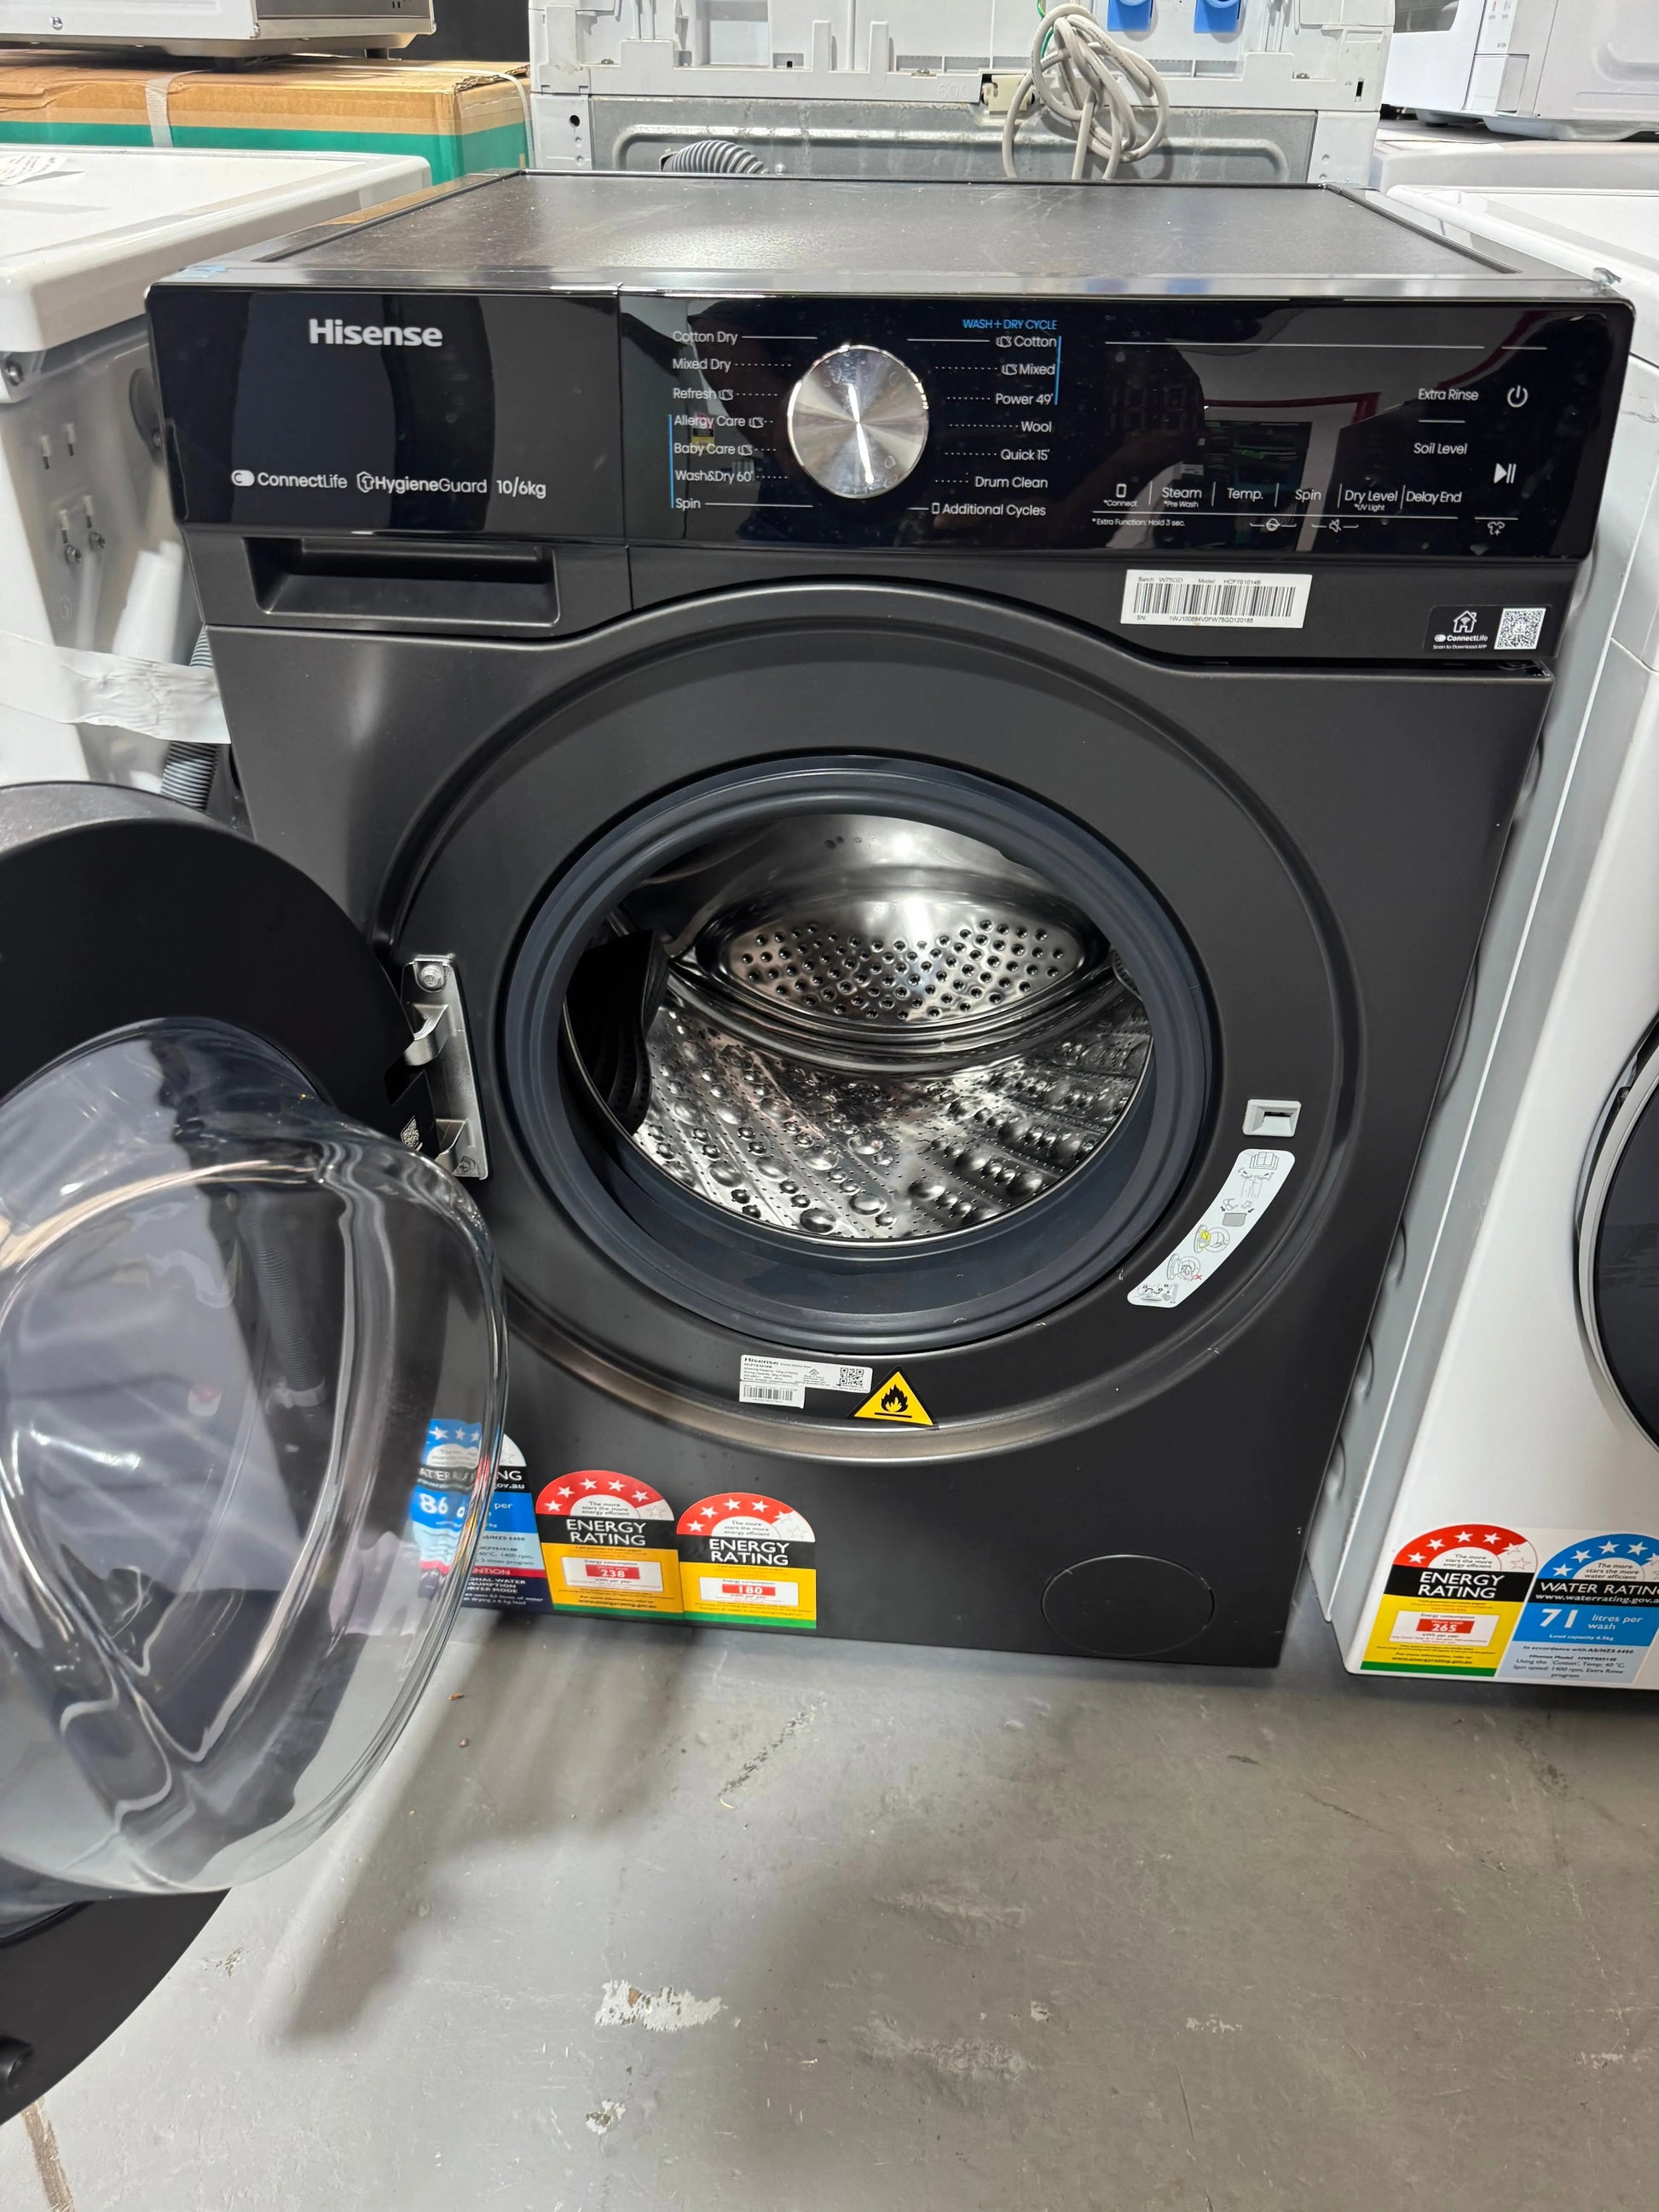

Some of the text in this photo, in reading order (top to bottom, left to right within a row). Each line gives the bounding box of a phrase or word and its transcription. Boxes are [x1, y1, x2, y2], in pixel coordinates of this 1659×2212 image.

[1026, 319, 1057, 330] CYCLE
[309, 318, 442, 348] Hisense
[673, 331, 737, 345] Cotton Dry
[1014, 335, 1057, 348] Cotton
[673, 358, 731, 373] Mixed Dry
[1020, 363, 1055, 376] Mixed
[673, 387, 716, 400] Refresh
[996, 393, 1033, 405] Power
[1418, 388, 1478, 401] Extra Rinse
[674, 414, 746, 429] Allergy Care
[1021, 421, 1052, 433] Wool
[673, 442, 736, 457] Baby Care
[1001, 448, 1035, 462] Quick
[1413, 442, 1467, 456] Soil Level
[675, 470, 734, 484] Wash&Dry
[974, 476, 1048, 489] Drum Clean
[257, 471, 546, 499] ConnectLife HygieneGuard 10/6kg
[1162, 487, 1202, 500] Steam
[1227, 488, 1263, 502] Temp.
[1295, 488, 1321, 504] Spin
[1344, 488, 1398, 505] Dry Level
[1406, 490, 1462, 505] Delay End
[675, 497, 701, 511] Spin
[942, 503, 1046, 517] Additional Cycles
[494, 1503, 512, 1511] per
[566, 1519, 646, 1533] ENERGY
[570, 1533, 646, 1545] RATING
[709, 1539, 789, 1553] ENERGY
[711, 1552, 789, 1565] RATING
[1419, 1572, 1504, 1585] ENERGY
[738, 1585, 763, 1594] 180
[1418, 1585, 1497, 1598] RATING
[1540, 1582, 1659, 1595] WATER RATIN
[1540, 1608, 1578, 1628] 71
[1593, 1614, 1620, 1622] litres
[1431, 1624, 1458, 1632] 265
